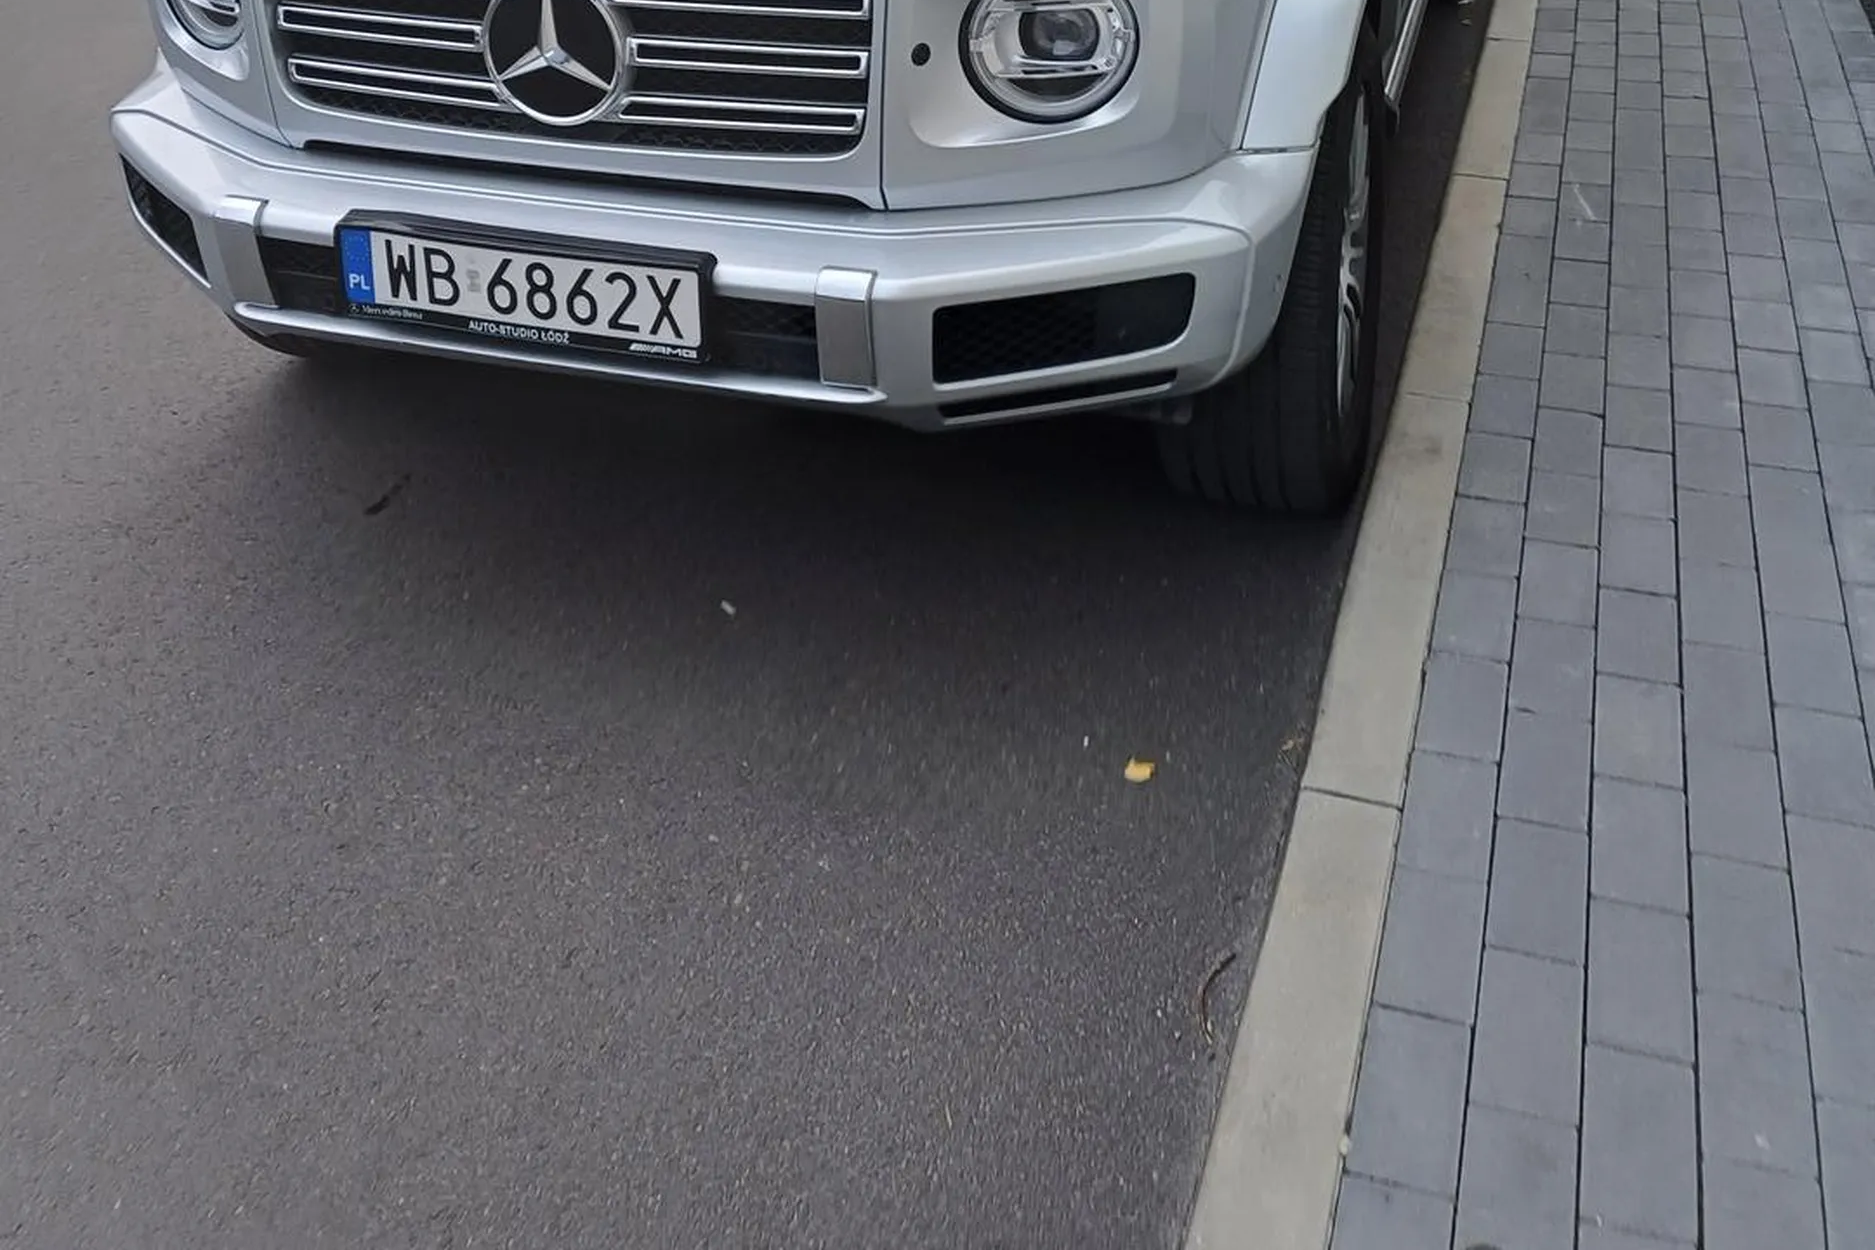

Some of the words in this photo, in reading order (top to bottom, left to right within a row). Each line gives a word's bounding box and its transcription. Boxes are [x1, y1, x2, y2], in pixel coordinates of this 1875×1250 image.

[348, 273, 371, 291] PL
[385, 239, 461, 307] WB
[487, 258, 684, 340] 6862X
[468, 319, 540, 339] AUTO-STUDIO
[541, 330, 571, 345] ŁÓDŹ
[646, 343, 698, 359] AMG
